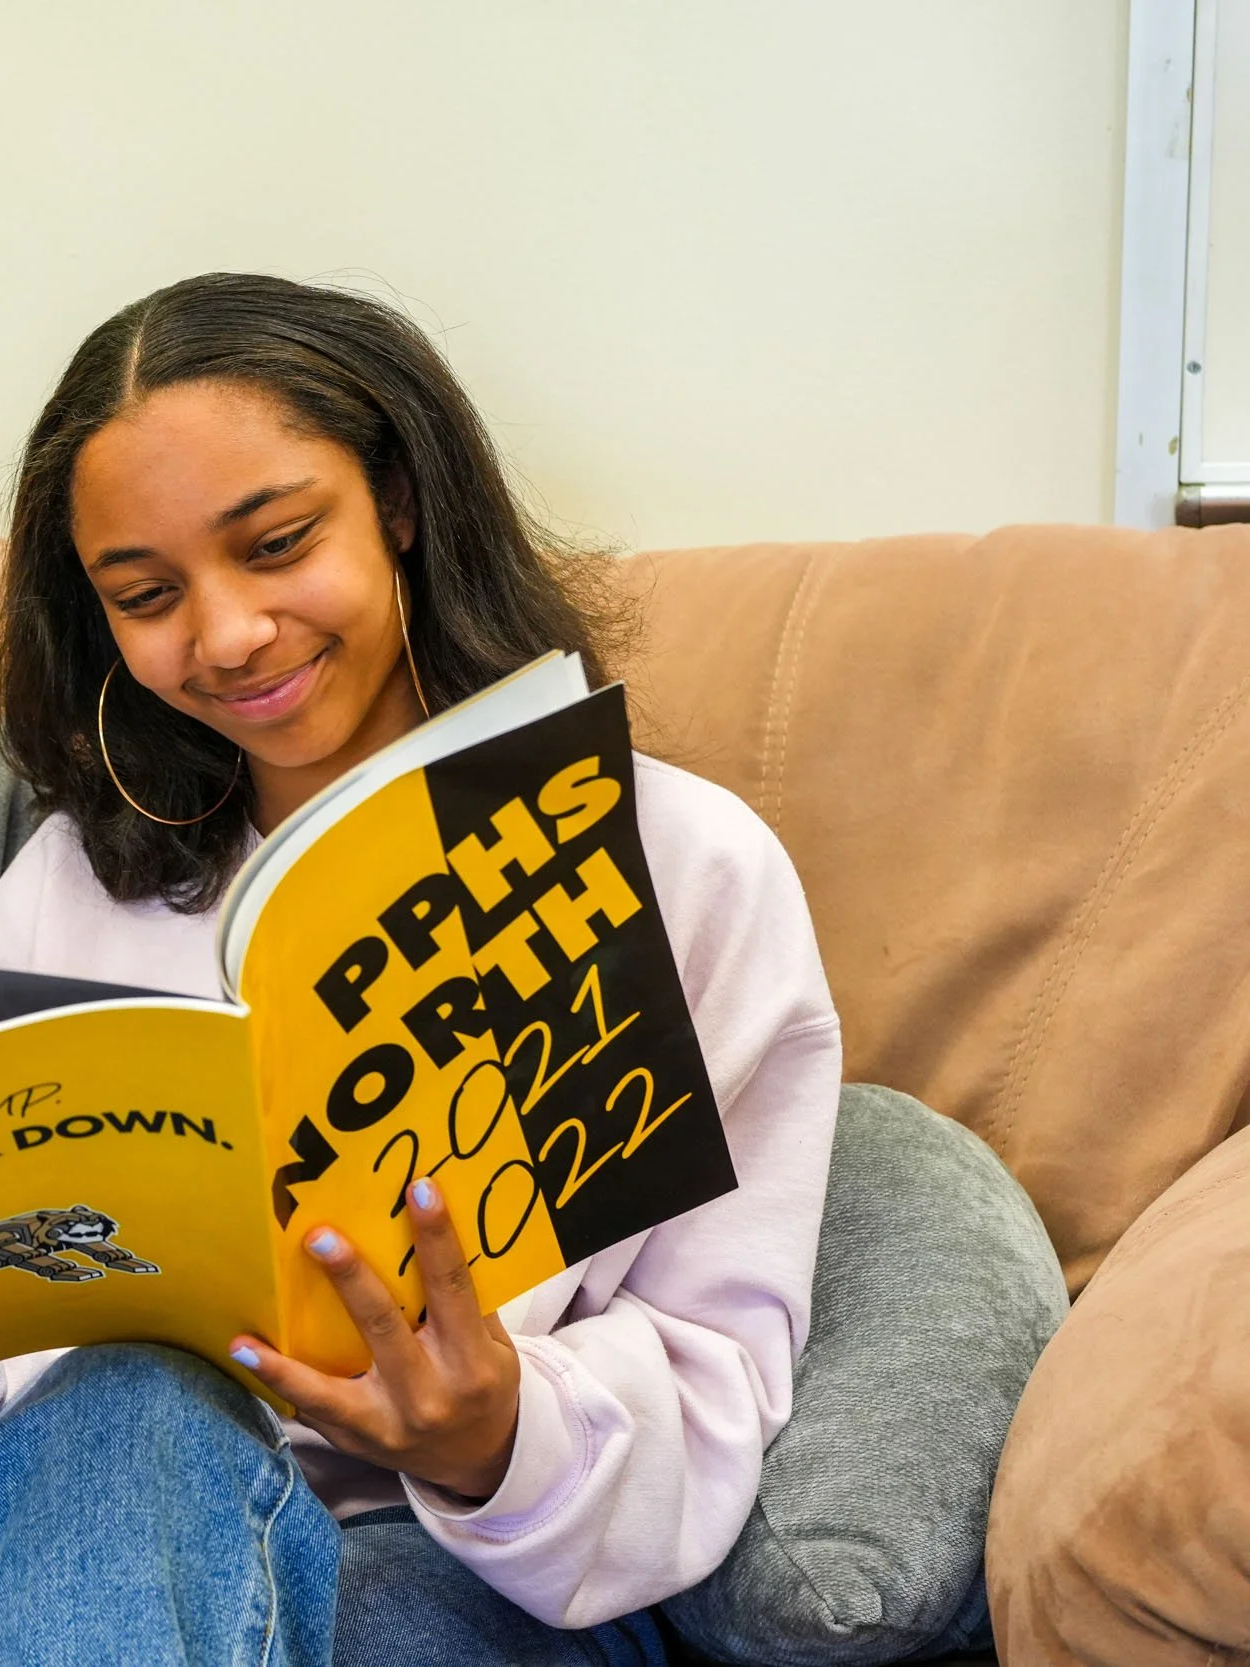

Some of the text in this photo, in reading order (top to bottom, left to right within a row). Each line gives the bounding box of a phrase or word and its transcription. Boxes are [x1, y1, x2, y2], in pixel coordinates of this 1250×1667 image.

[313, 755, 622, 1034] PPHS
[12, 1110, 234, 1151] DOWN.
[271, 846, 643, 1232] NORTH
[373, 963, 640, 1218] 2021
[398, 1067, 692, 1324] 022
